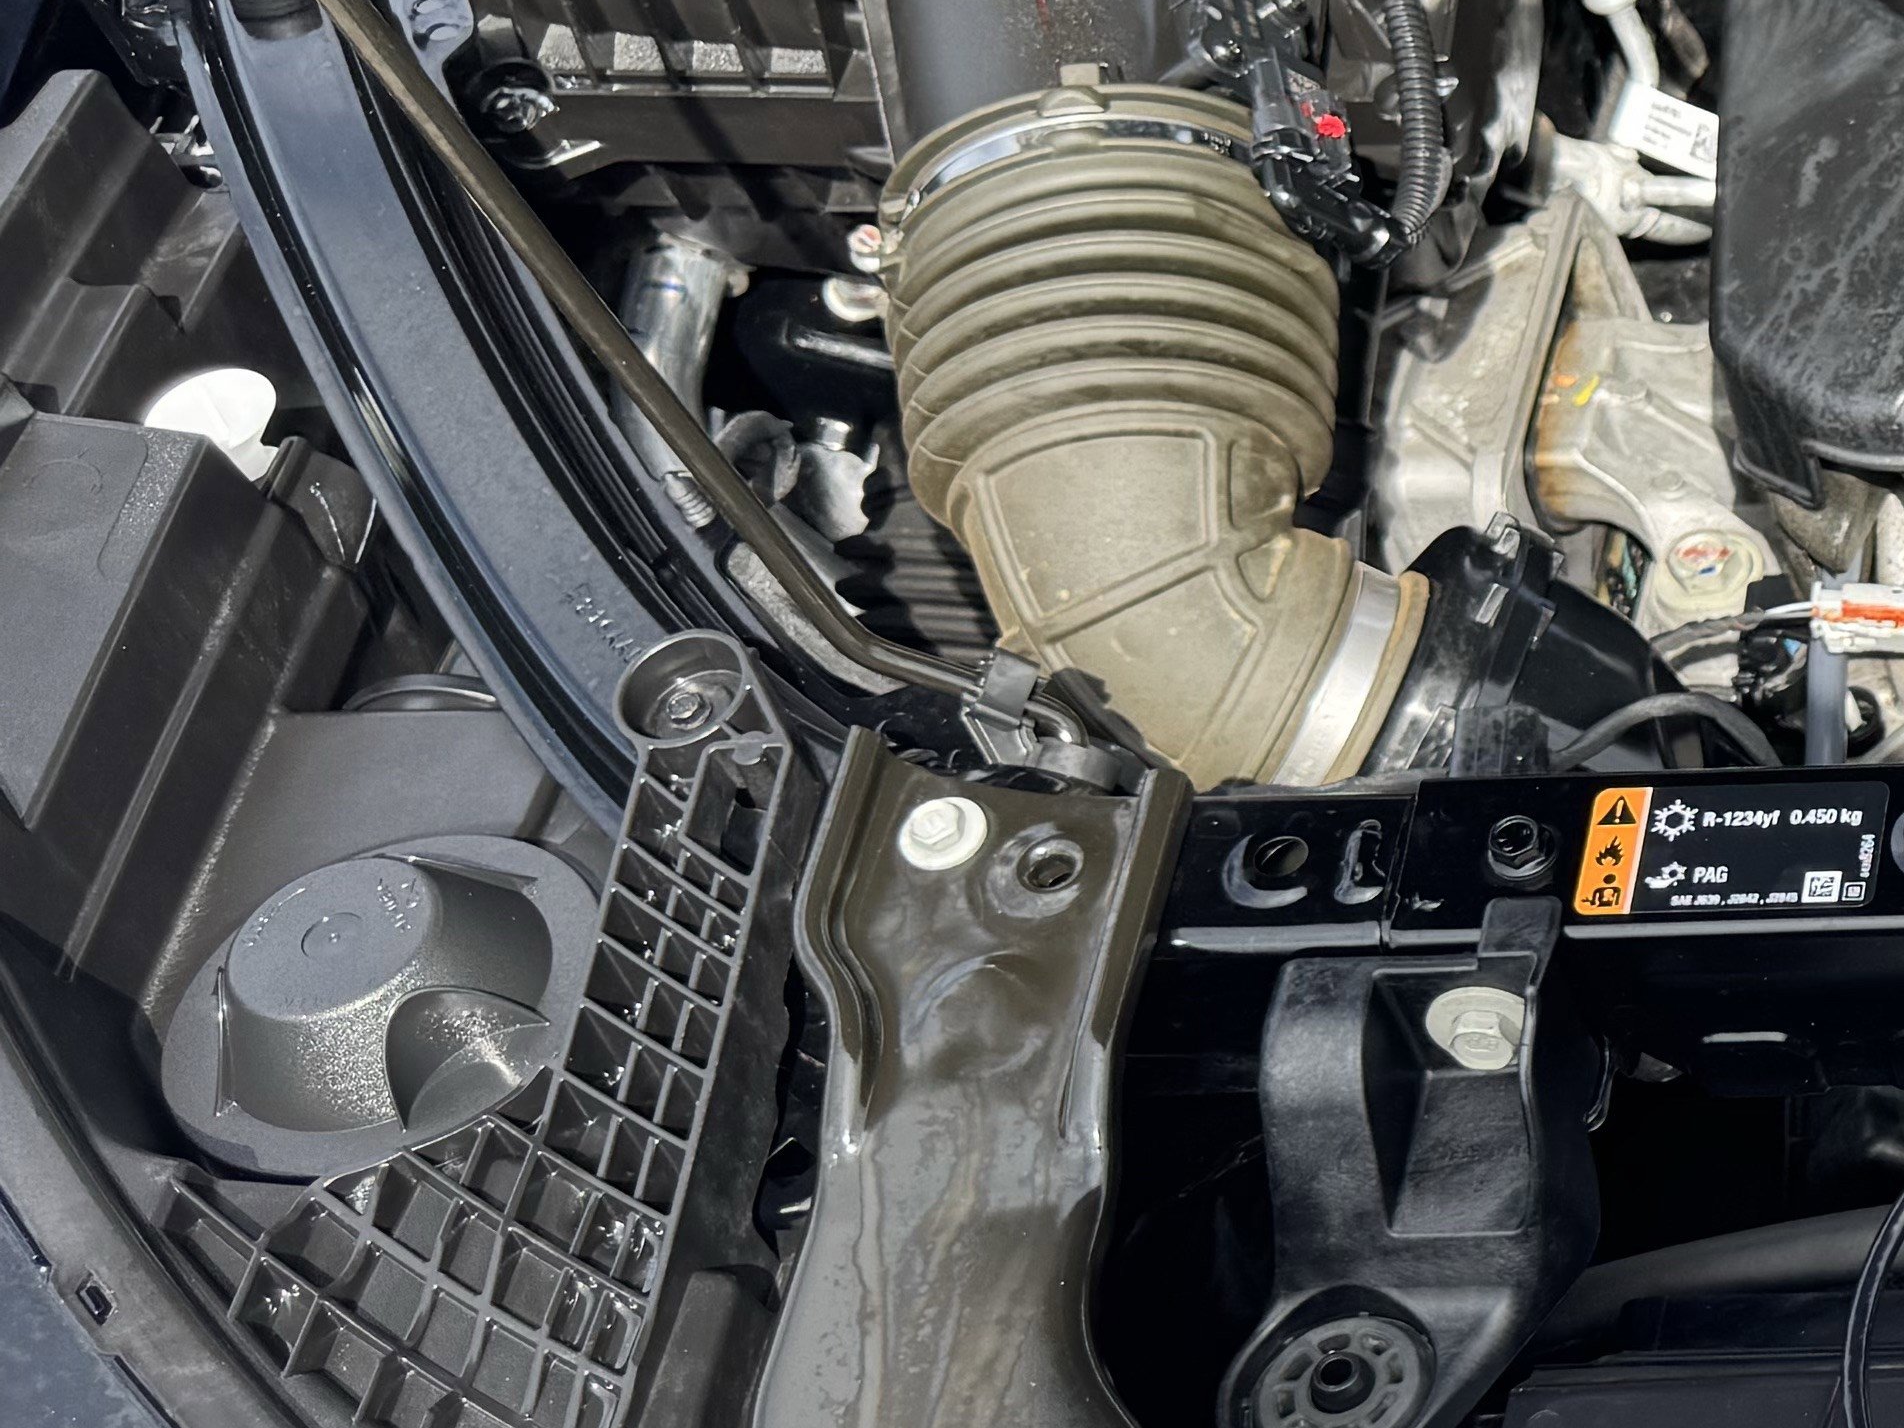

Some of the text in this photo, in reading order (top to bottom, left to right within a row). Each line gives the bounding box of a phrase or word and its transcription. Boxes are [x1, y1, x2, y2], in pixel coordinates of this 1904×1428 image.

[1703, 808, 1863, 829] R-1234yf 0.450 kg
[1693, 867, 1728, 883] PAG
